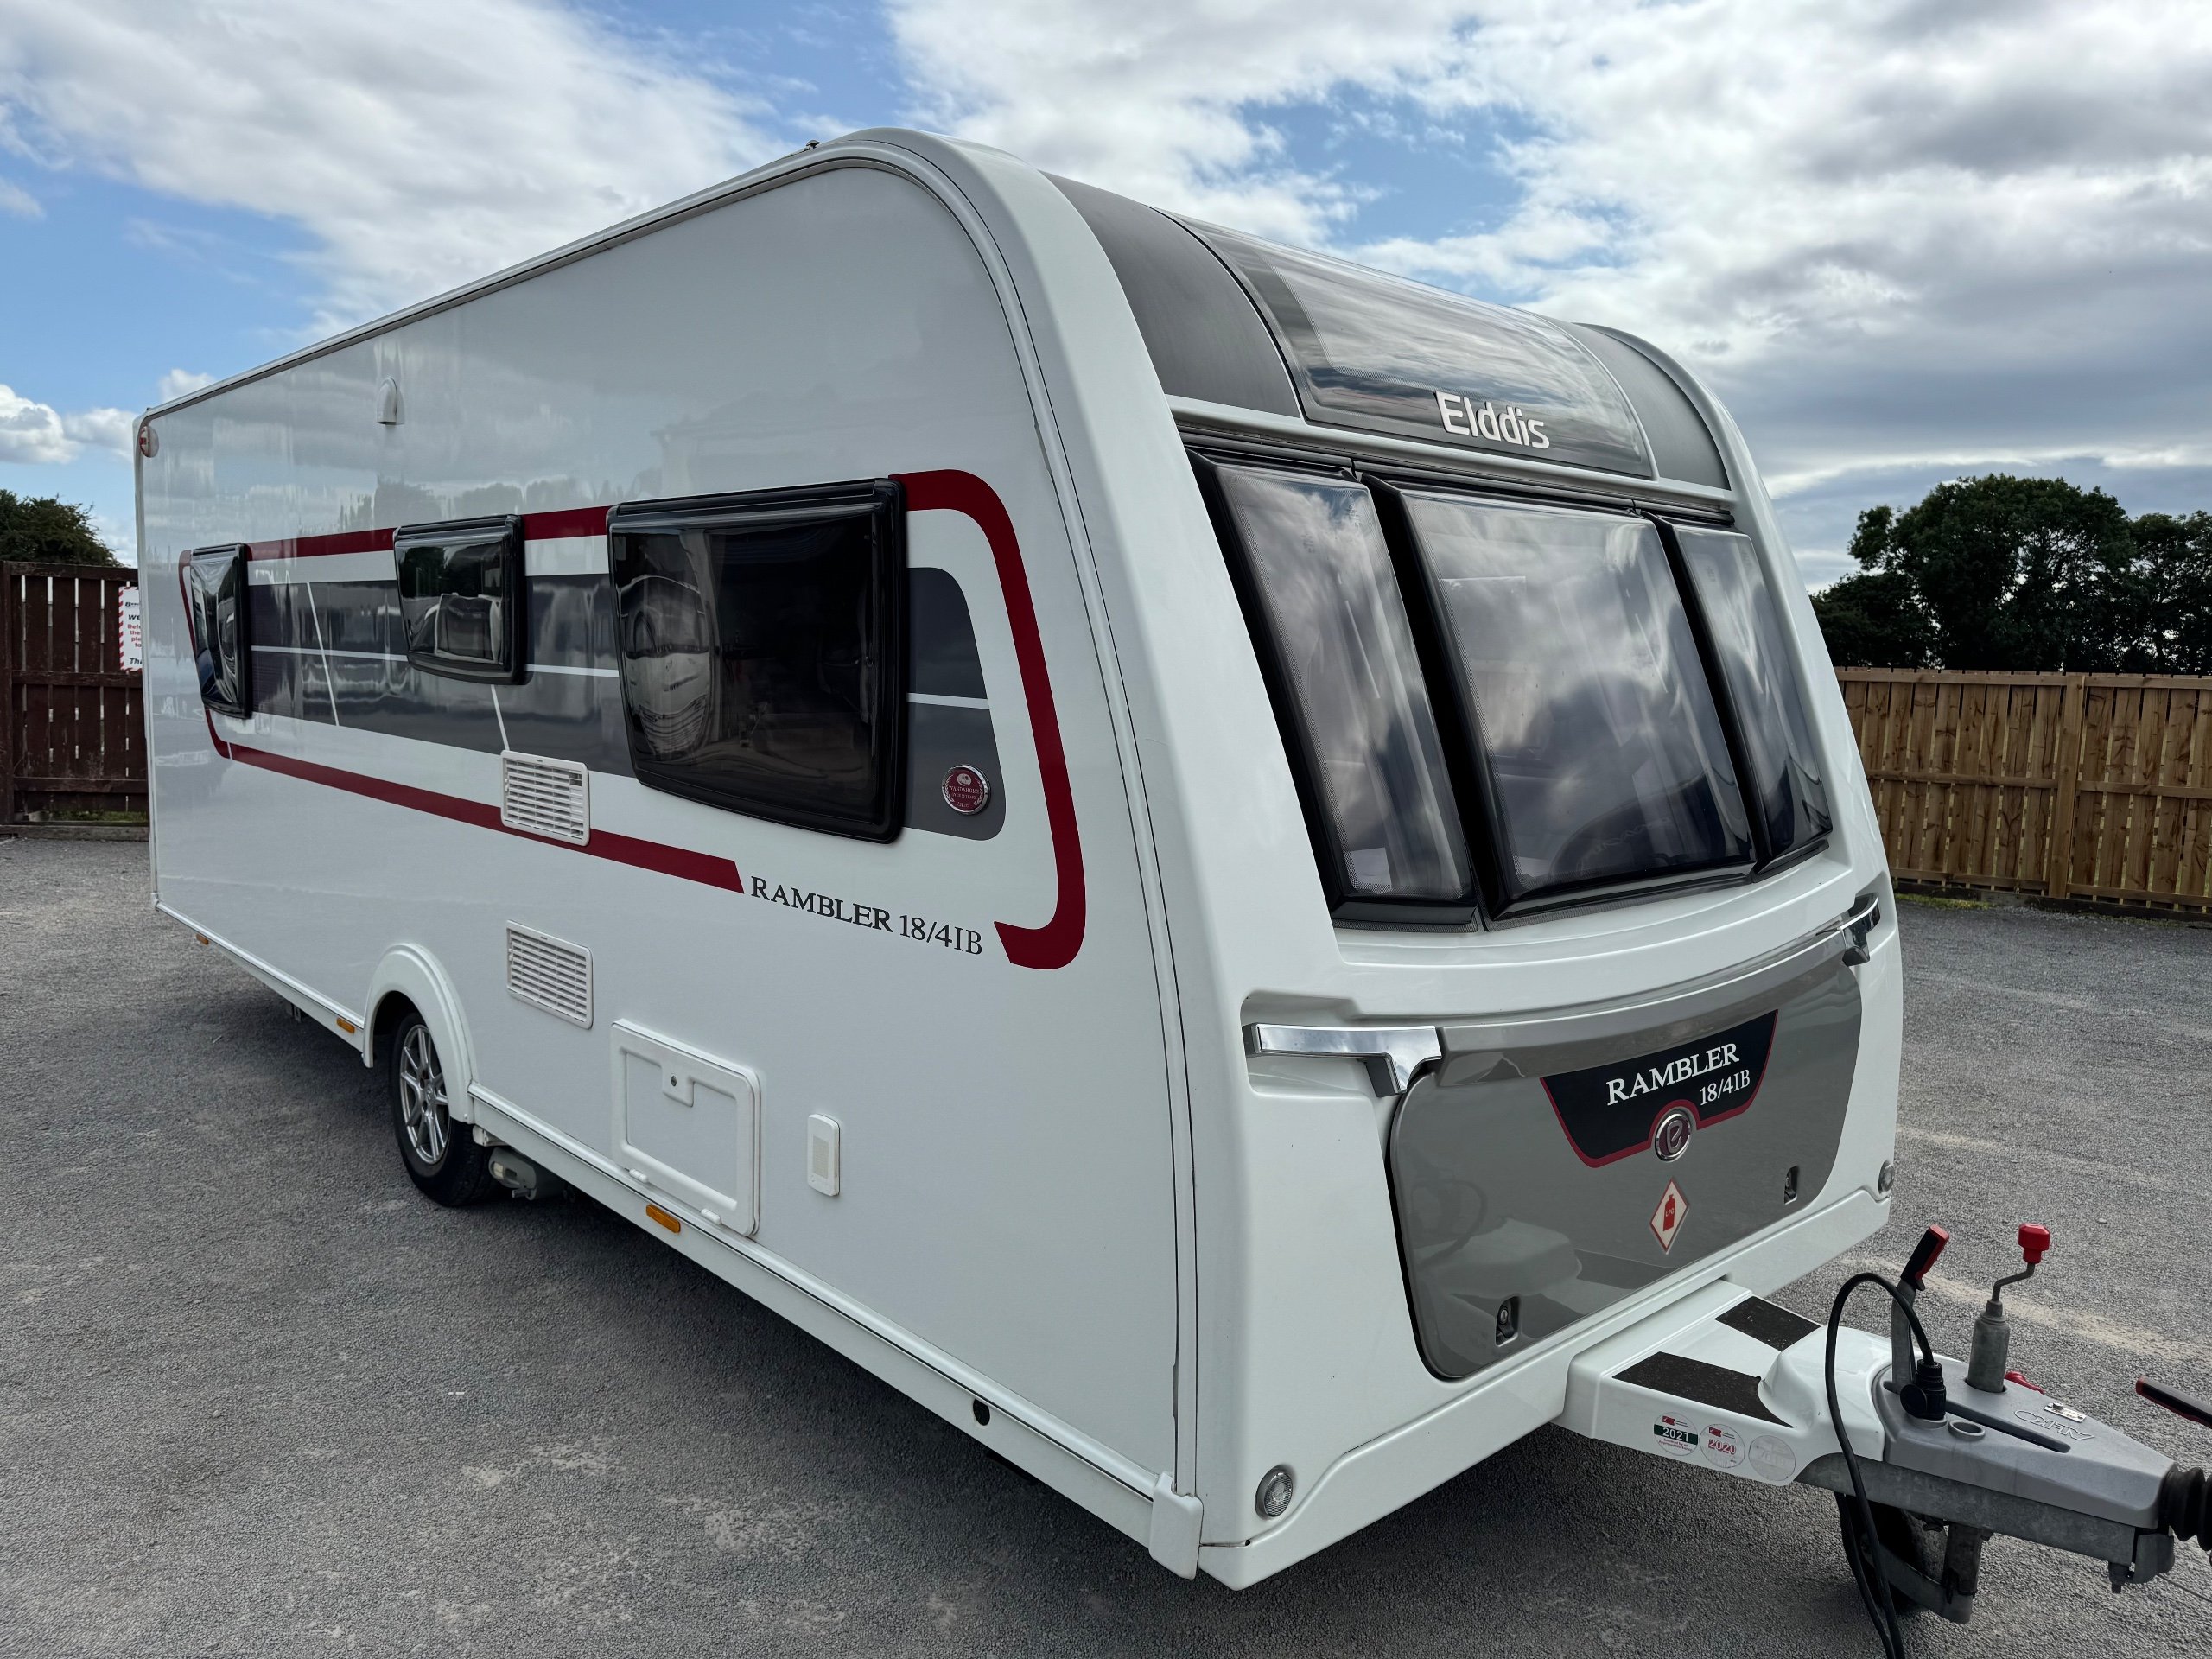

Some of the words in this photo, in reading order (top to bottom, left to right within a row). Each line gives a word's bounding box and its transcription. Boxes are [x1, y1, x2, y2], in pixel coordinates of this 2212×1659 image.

[1434, 391, 1550, 449] Elddis
[750, 875, 894, 933] RAMBLER
[1605, 1043, 1740, 1106] RAMBLER
[1665, 1208, 1675, 1217] LPG
[1662, 1427, 1689, 1442] 2021
[1708, 1440, 1737, 1455] 2020
